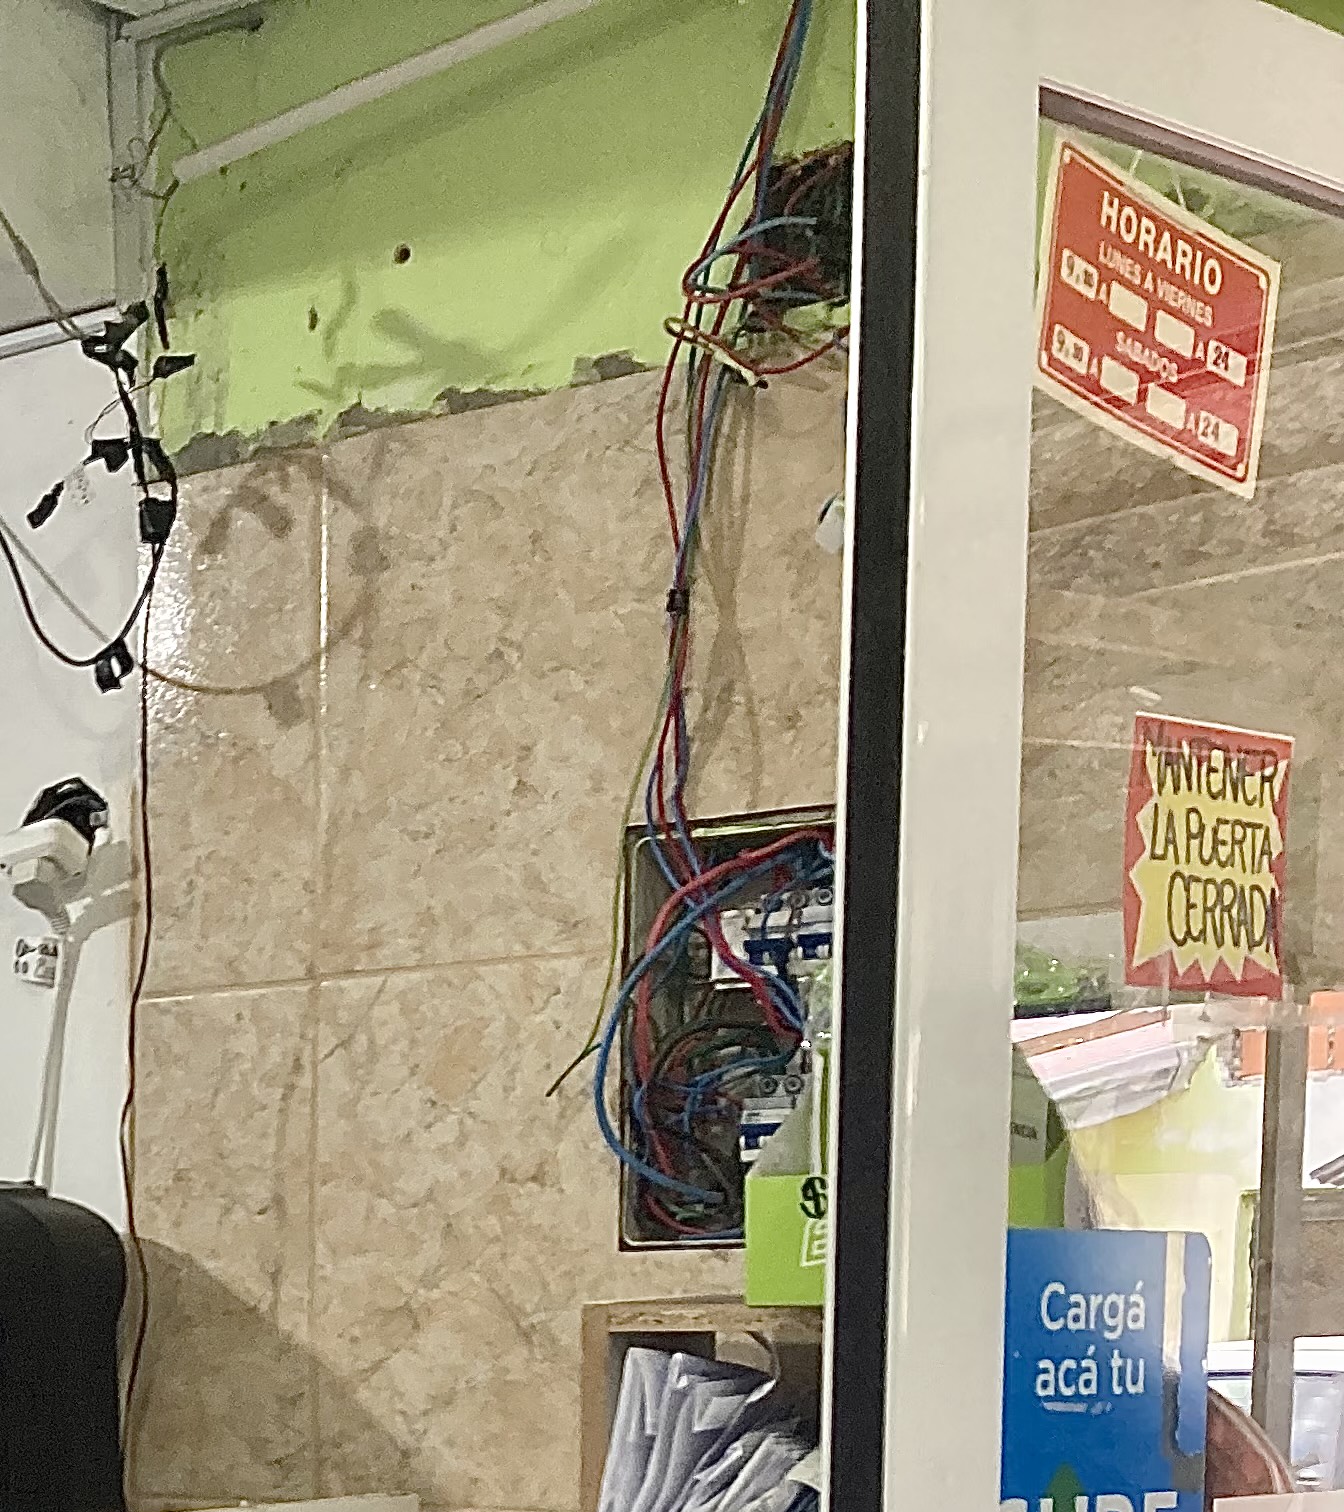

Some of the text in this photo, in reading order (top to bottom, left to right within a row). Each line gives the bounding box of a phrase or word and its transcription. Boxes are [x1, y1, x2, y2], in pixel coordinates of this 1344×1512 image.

[1100, 190, 1223, 296] HORARIO
[1099, 240, 1213, 328] LUNES A VIERNES
[1149, 803, 1274, 875] LA PUERTA
[1040, 1280, 1147, 1339] Cargá
[1035, 1346, 1146, 1397] acá tu
